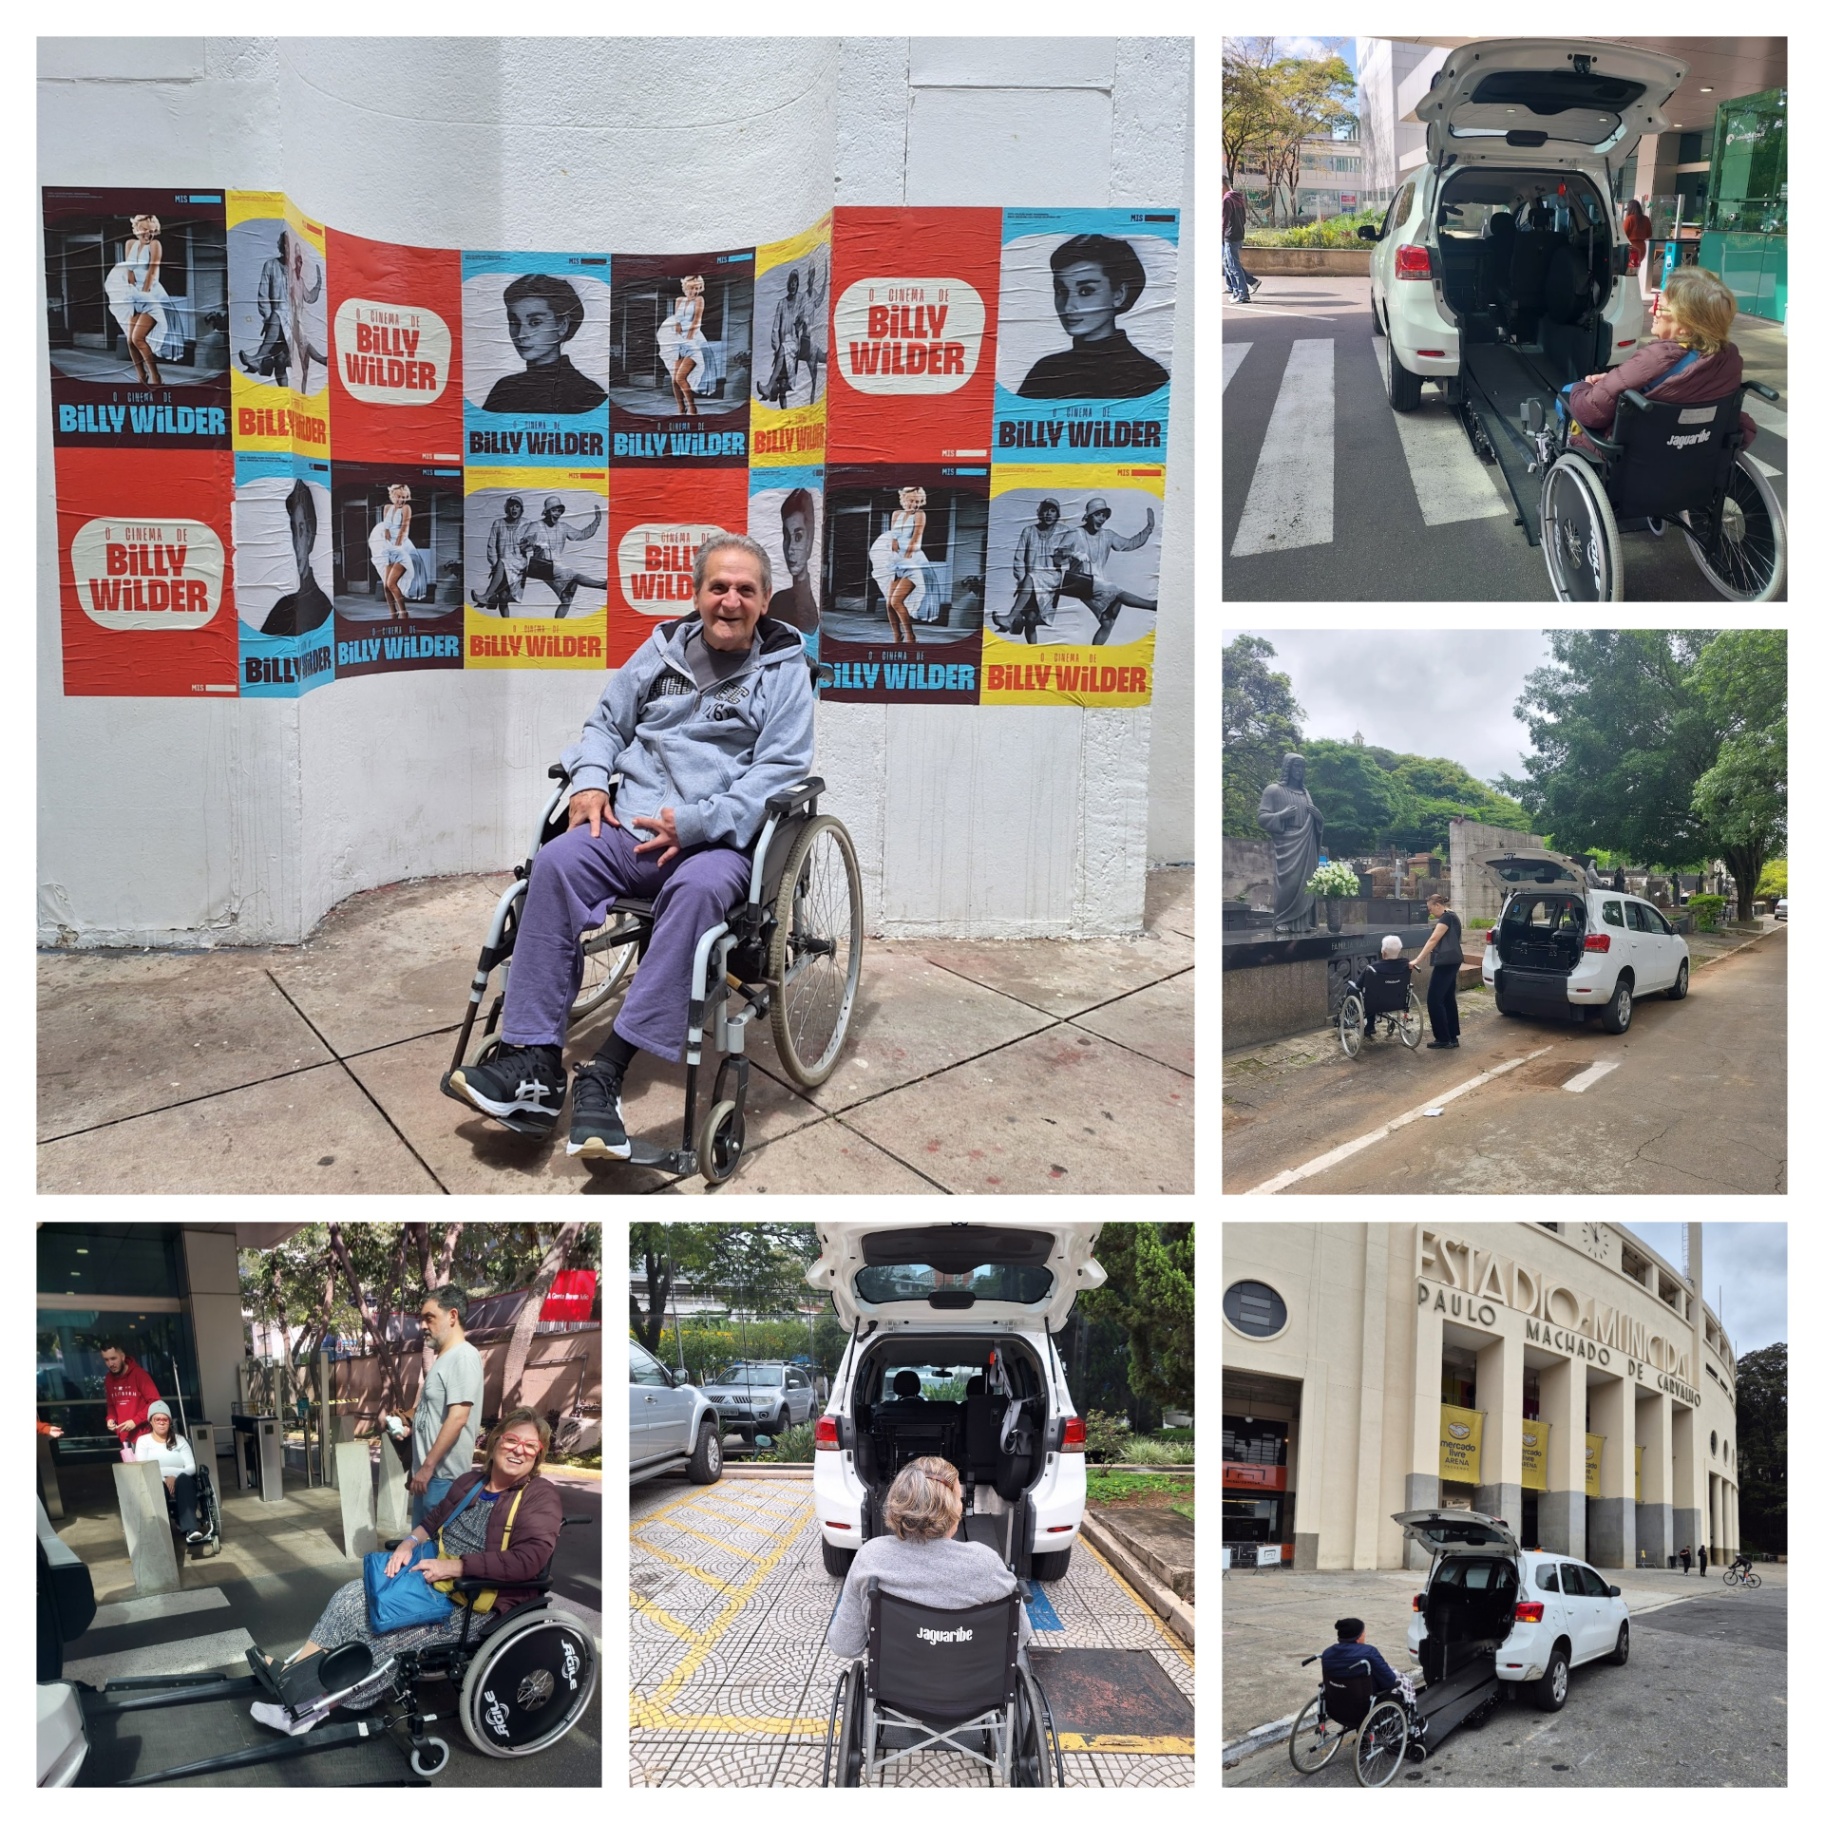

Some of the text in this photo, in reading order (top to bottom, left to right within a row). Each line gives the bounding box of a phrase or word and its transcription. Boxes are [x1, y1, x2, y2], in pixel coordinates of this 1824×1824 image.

[175, 195, 188, 203] MIS
[1130, 214, 1143, 222] MIS
[869, 288, 950, 302] O CINEMA DE
[370, 311, 399, 326] CINEMA
[1067, 408, 1093, 418] CINEMA
[941, 468, 955, 476] MIS
[1117, 469, 1130, 477] MIS
[105, 527, 188, 542] O CINEMA DE
[661, 532, 690, 543] CINEMA
[882, 651, 908, 661] CINEMA
[1054, 653, 1080, 662] CINEMA
[191, 684, 205, 692] MIS
[1418, 1282, 1702, 1407] PAULO MACHADO DE CARVALHO
[1440, 1440, 1476, 1452] mercado
[1449, 1449, 1466, 1459] livre
[1445, 1457, 1470, 1467] ARENA
